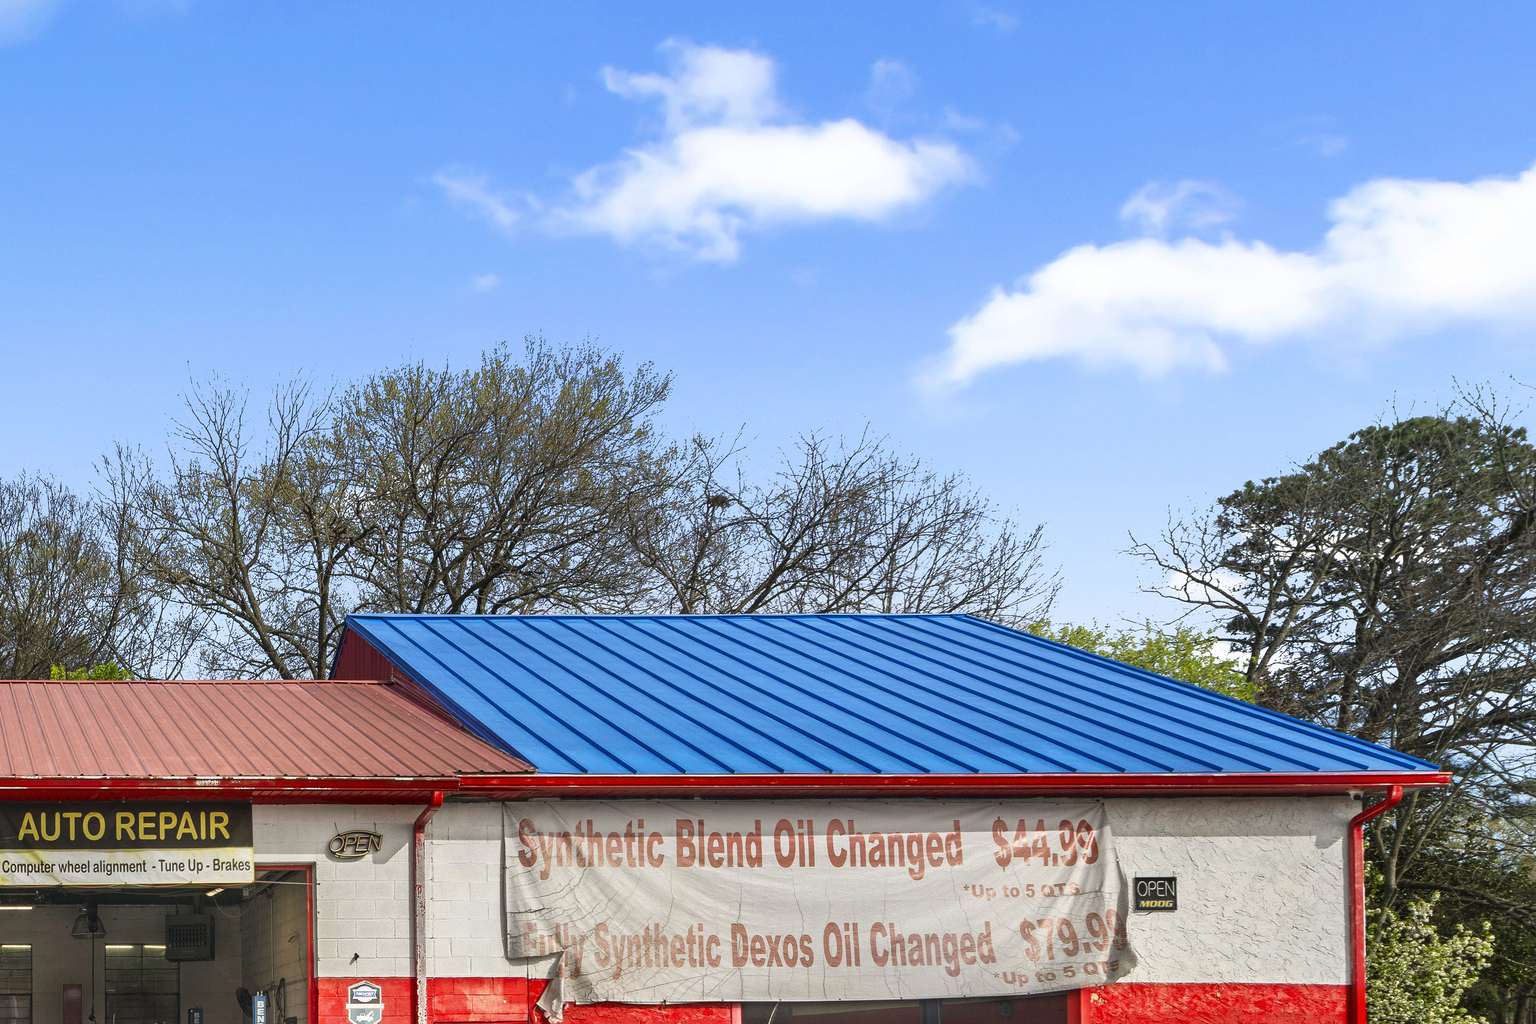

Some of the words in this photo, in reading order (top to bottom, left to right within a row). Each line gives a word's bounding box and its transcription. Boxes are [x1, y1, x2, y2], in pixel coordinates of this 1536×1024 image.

[18, 812, 106, 841] AUTO
[115, 811, 231, 840] REPAIR
[330, 835, 383, 852] OPEN
[518, 818, 664, 880] Synthetic
[676, 819, 763, 868] Blend
[774, 818, 815, 868] Oil
[826, 819, 963, 881] Changed
[992, 816, 1099, 872] $44.99
[2, 860, 56, 876] Computer
[59, 859, 90, 874] wheel
[93, 859, 147, 876] alignment
[158, 859, 185, 873] Tune
[188, 858, 204, 875] Up
[213, 858, 251, 872] Brakes
[1003, 884, 1019, 898] to
[1026, 884, 1035, 898] 5
[1041, 882, 1080, 898] QTS
[1137, 881, 1175, 896] OPEN
[1140, 900, 1174, 908] MOOG
[522, 922, 585, 980] Fully
[594, 922, 721, 980] Synthetic
[731, 923, 814, 968] Dexos
[823, 922, 861, 968] Oil
[869, 921, 997, 977] Changed
[1034, 969, 1057, 983] to
[1064, 965, 1076, 978] 5
[1082, 960, 1119, 975] QTS
